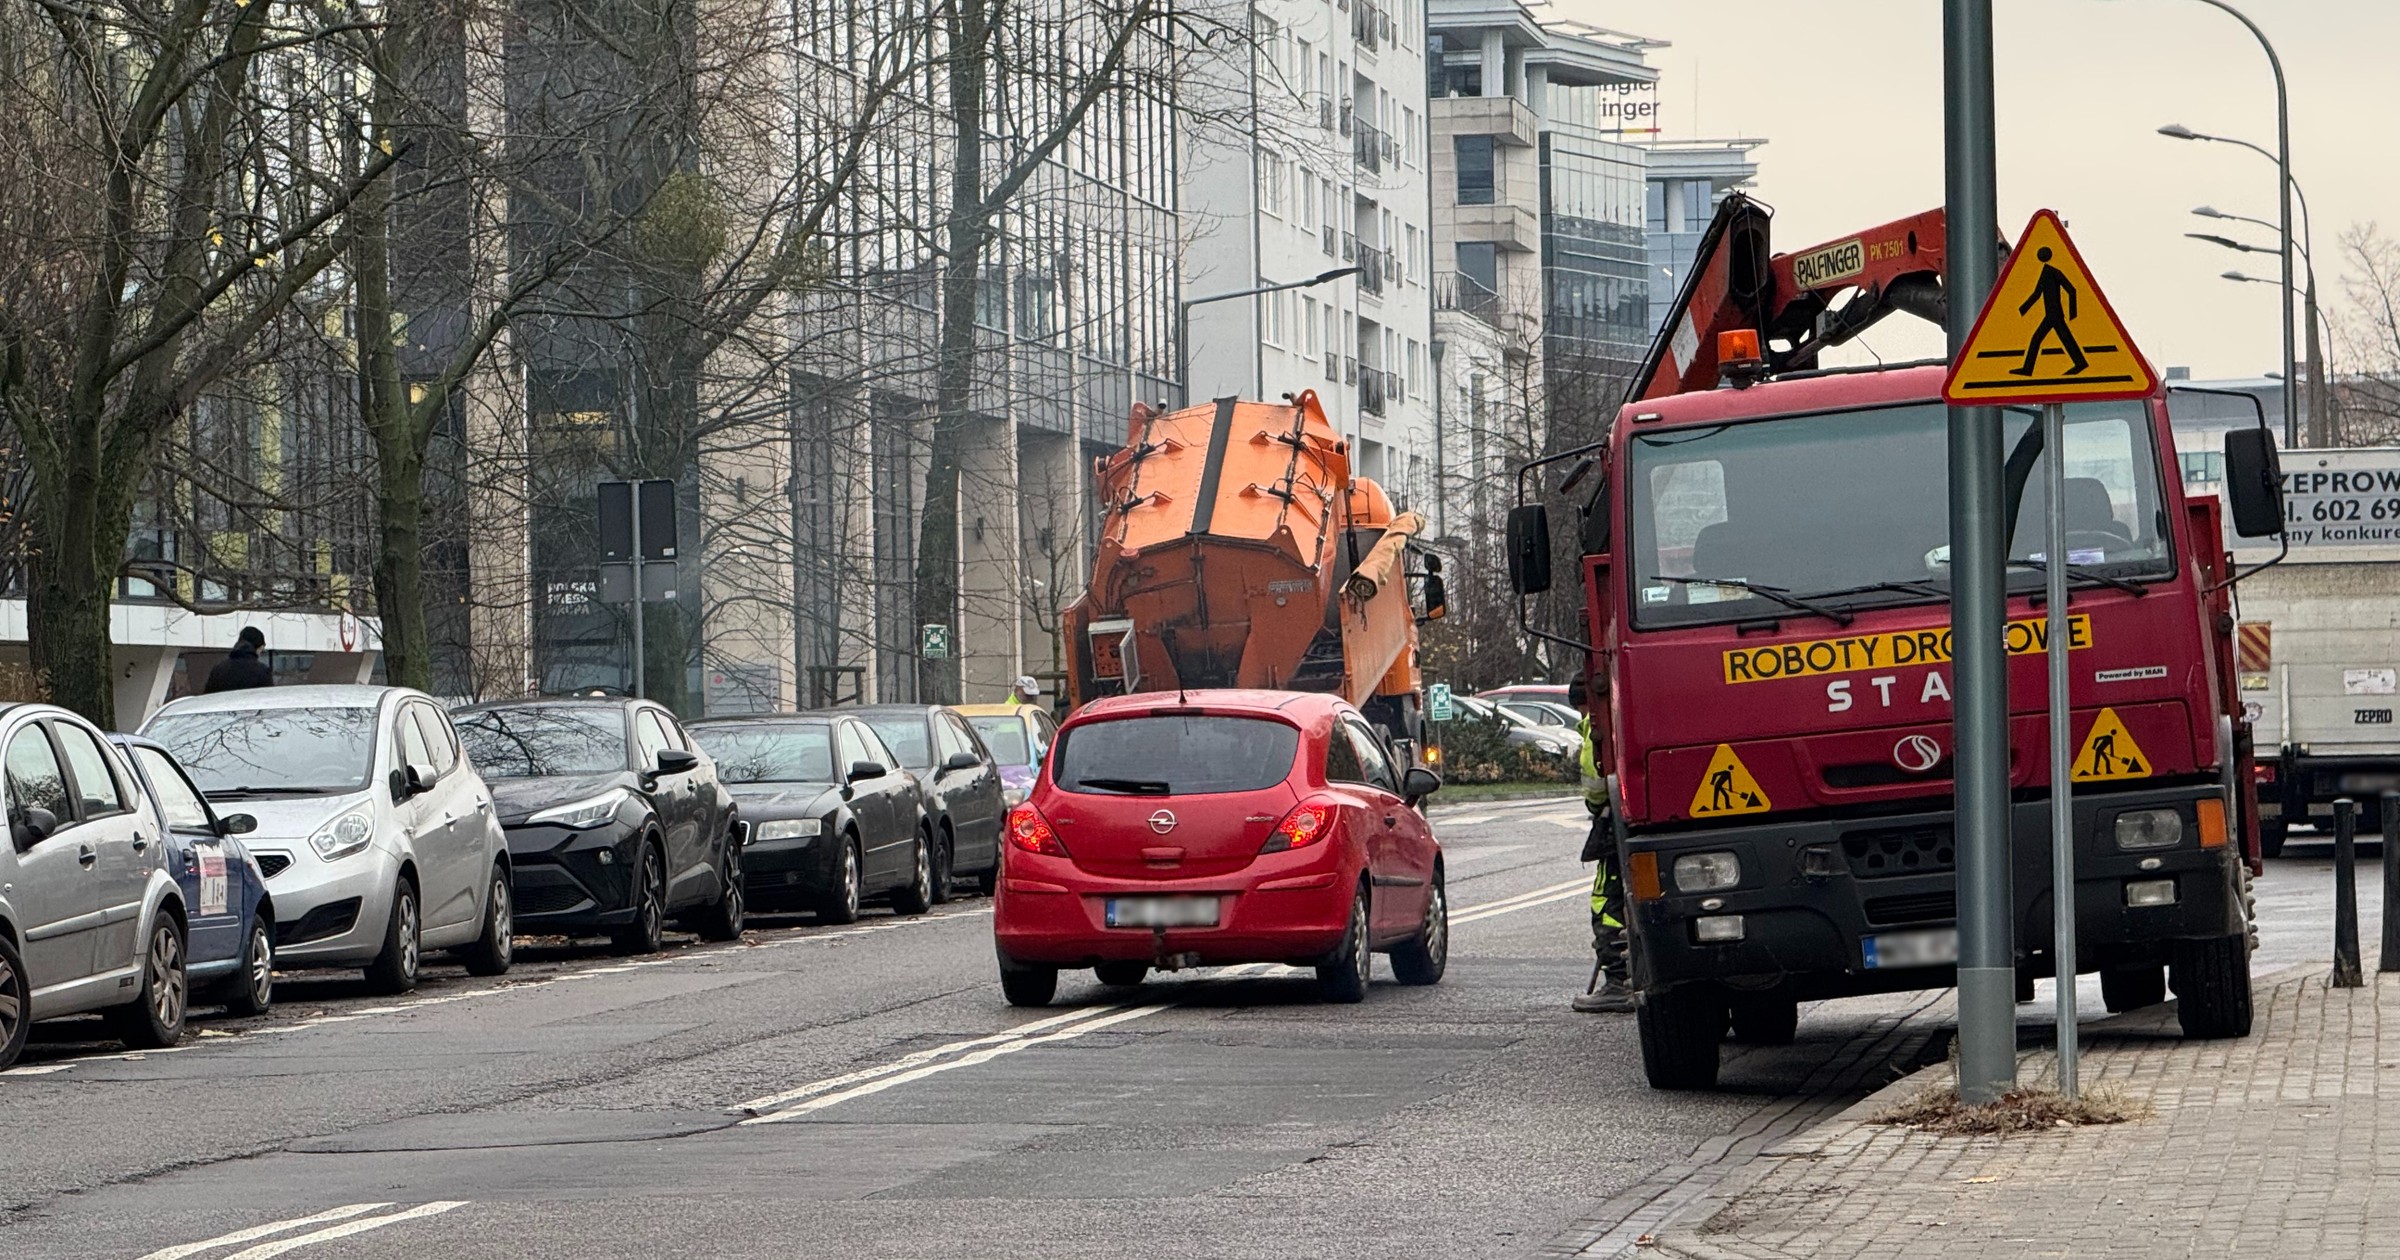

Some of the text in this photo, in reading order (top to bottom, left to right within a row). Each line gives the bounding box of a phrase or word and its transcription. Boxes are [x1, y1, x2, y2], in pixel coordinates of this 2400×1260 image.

[1600, 97, 1661, 121] inger
[1869, 240, 1904, 261] PK 7501
[1797, 243, 1861, 284] PALFINGER
[2280, 470, 2400, 494] ZEPROW
[2312, 499, 2361, 522] 602
[2371, 498, 2400, 520] 69
[1729, 616, 2086, 681] ROBOTY DROE
[2098, 668, 2164, 680] Powered by MAN
[1827, 671, 1951, 712] STA
[2354, 709, 2393, 724] ZEPRO
